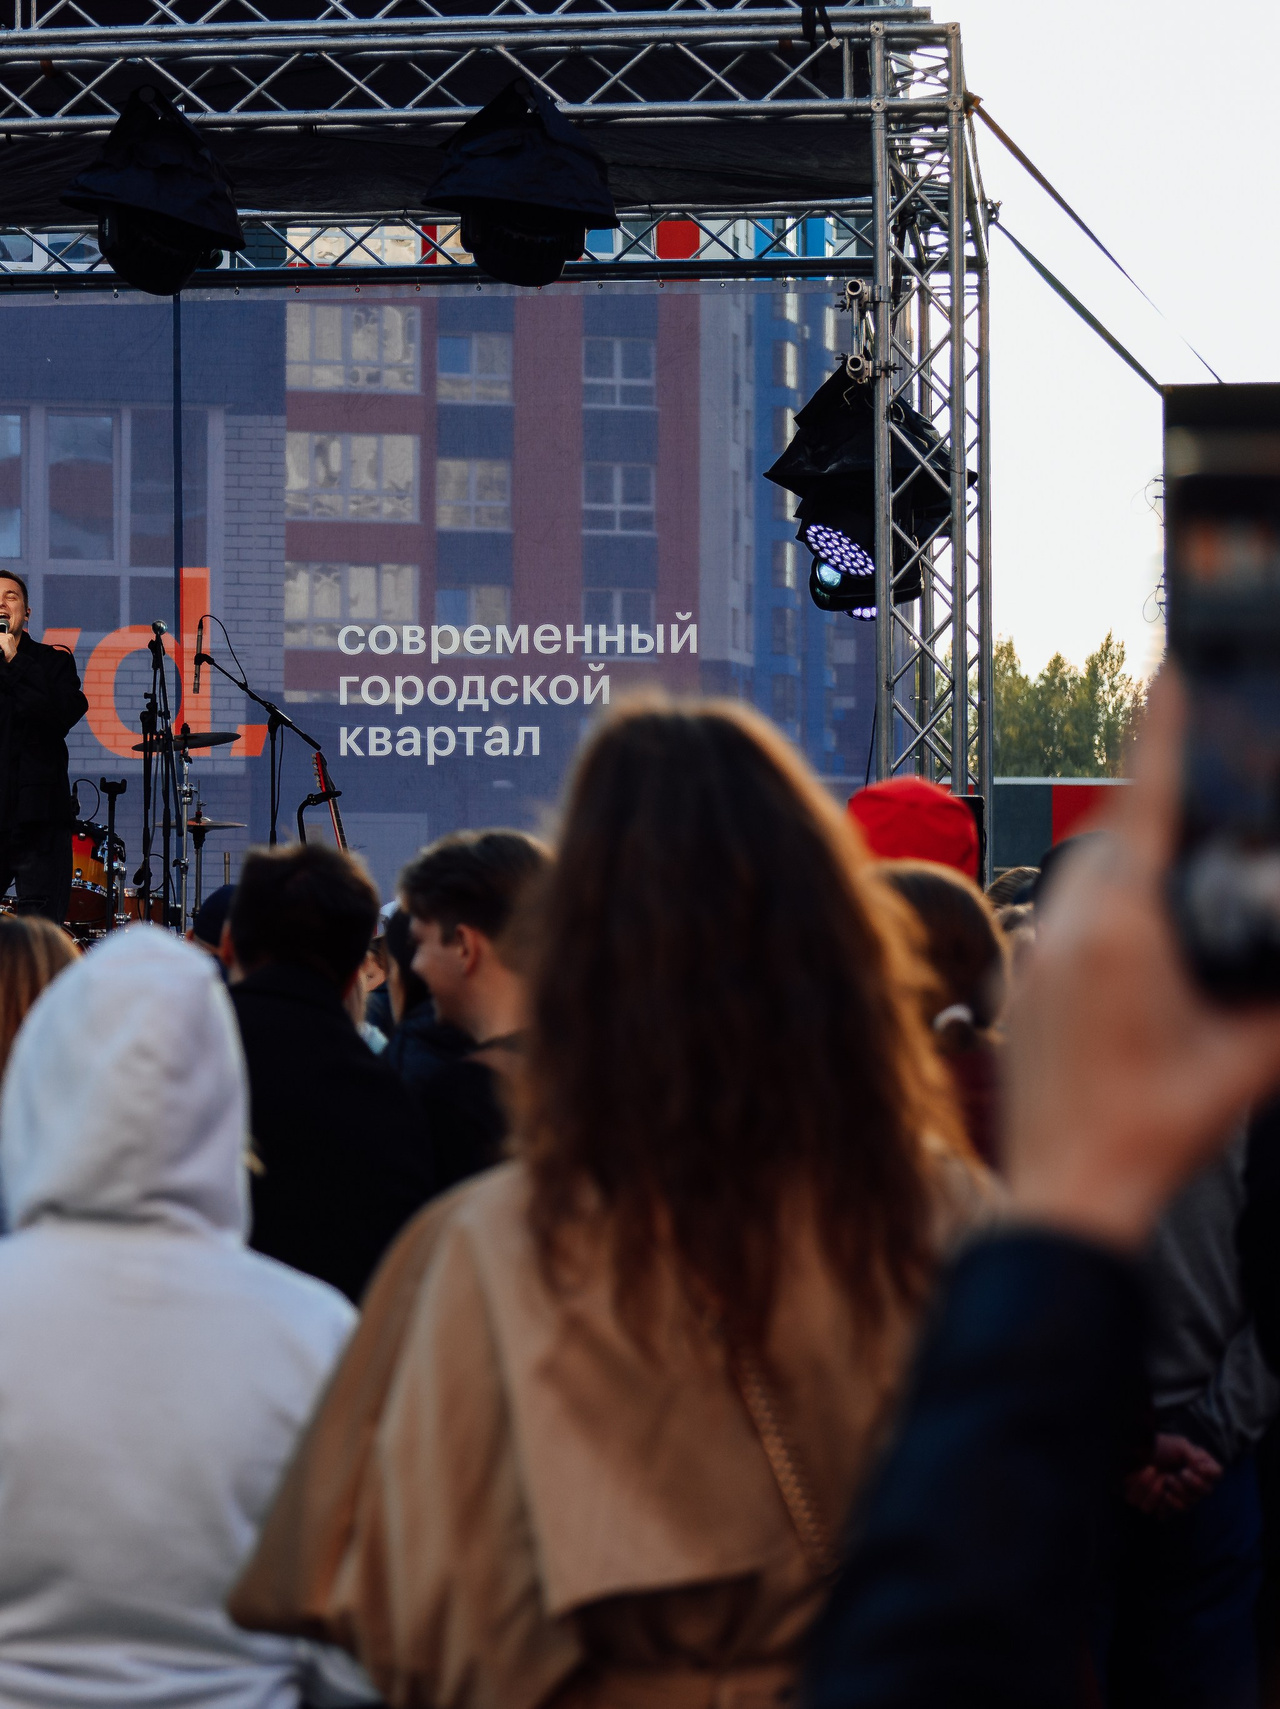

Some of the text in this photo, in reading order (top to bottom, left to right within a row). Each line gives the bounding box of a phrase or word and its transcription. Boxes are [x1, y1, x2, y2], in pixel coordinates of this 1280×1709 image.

[337, 611, 698, 664] современный
[339, 662, 611, 715] городской
[339, 724, 541, 766] квартал
